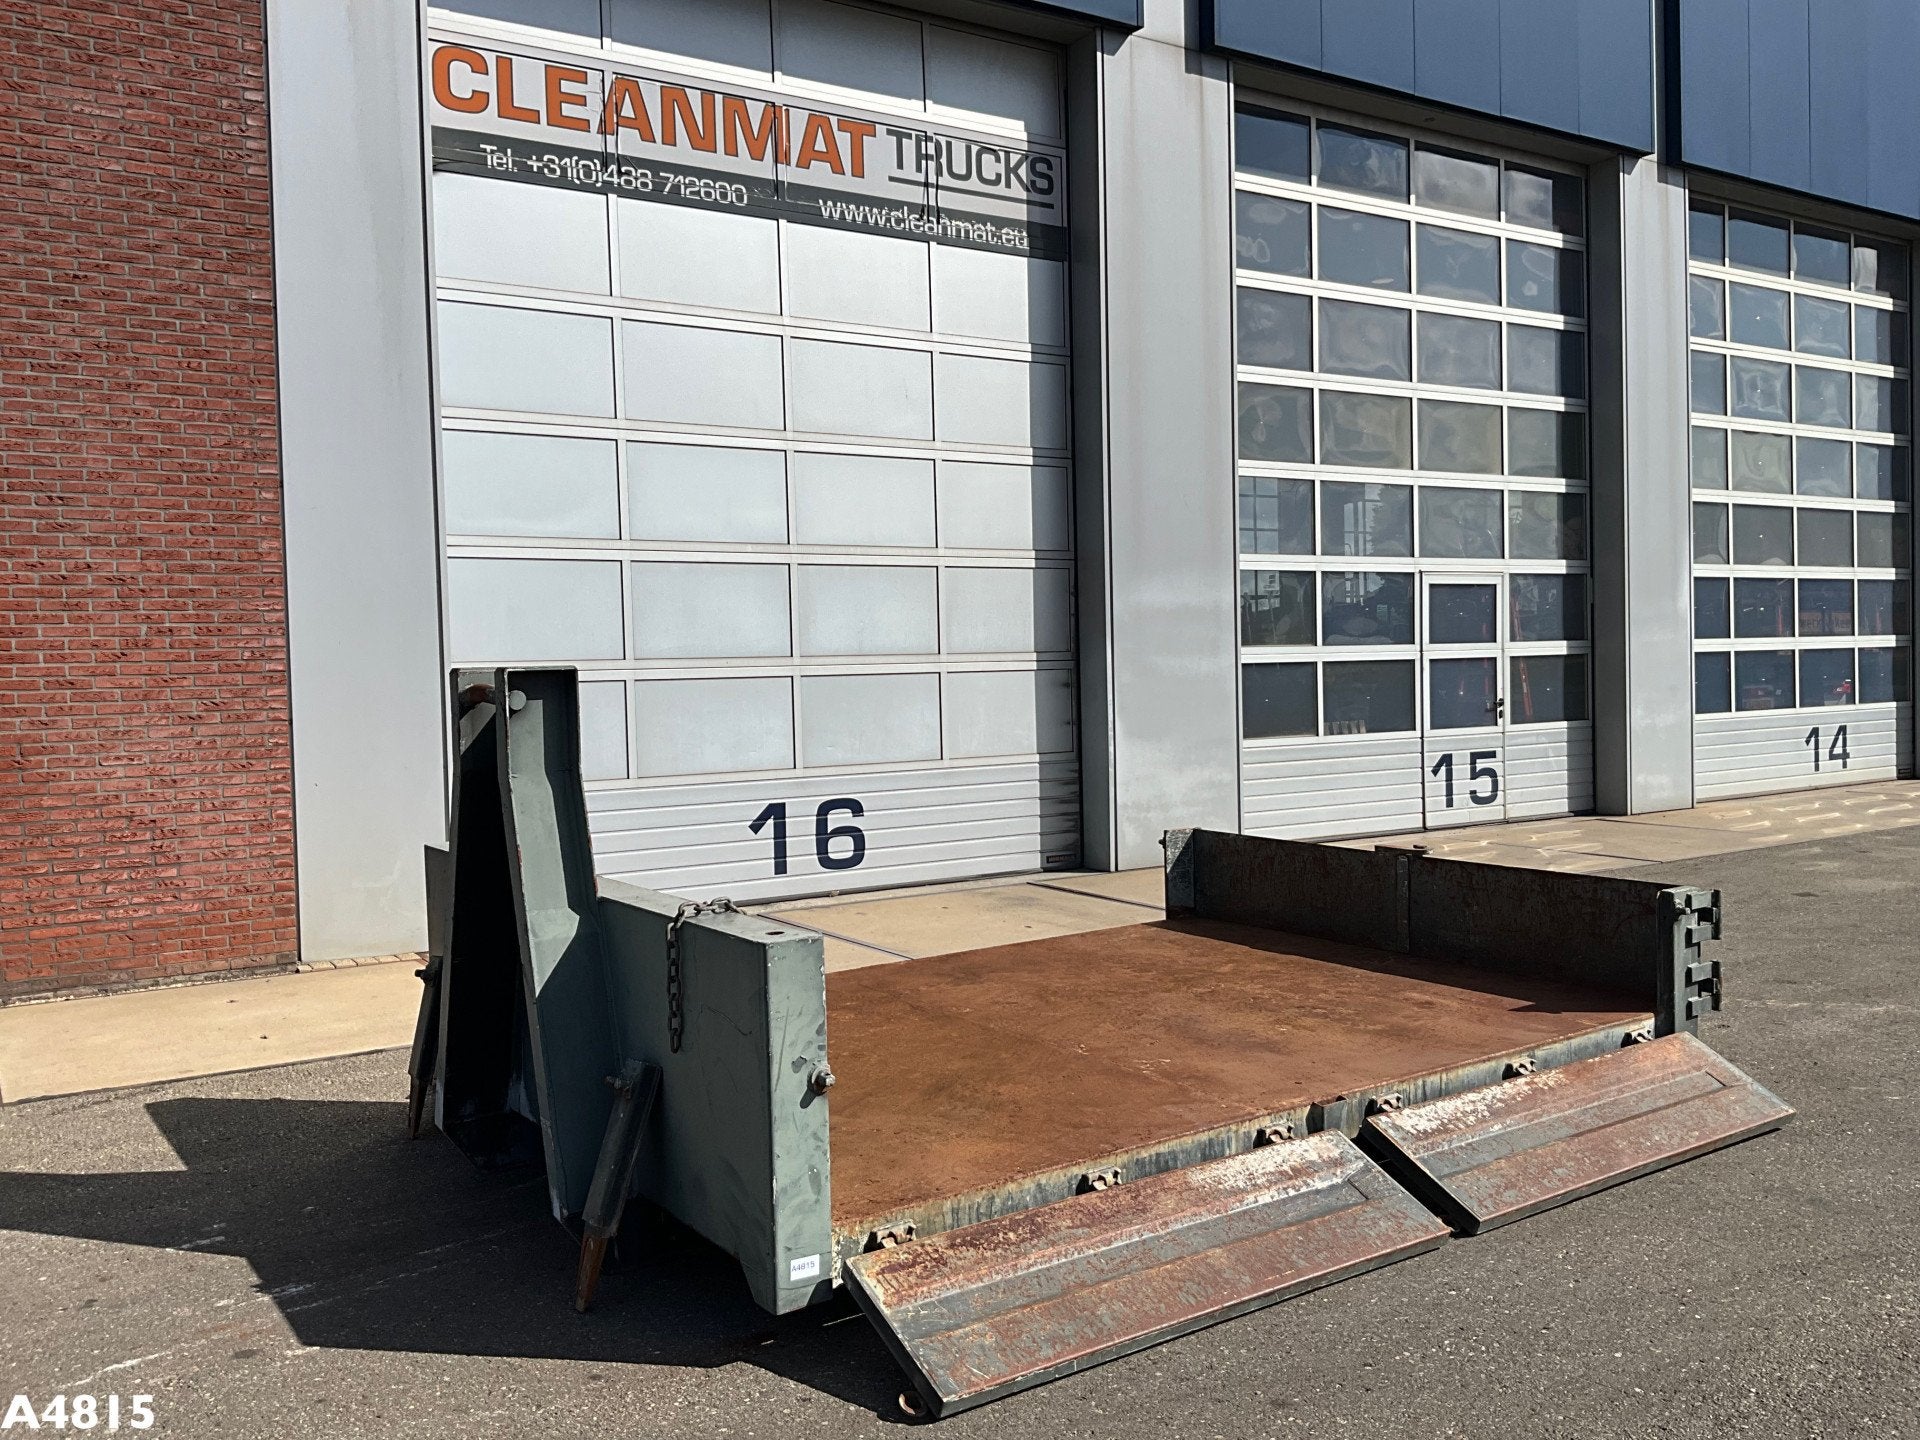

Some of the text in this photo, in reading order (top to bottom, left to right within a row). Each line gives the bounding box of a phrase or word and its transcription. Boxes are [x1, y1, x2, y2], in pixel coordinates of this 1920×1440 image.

[431, 45, 1055, 197] CLEANMAT TRUCKS
[480, 143, 518, 172] Tel.
[659, 171, 748, 207] 712600
[818, 199, 1030, 248] www.cleanmat.eu
[1804, 724, 1851, 772] 14
[1430, 750, 1499, 808] 15
[748, 797, 866, 876] 16
[791, 1260, 816, 1272] A4815
